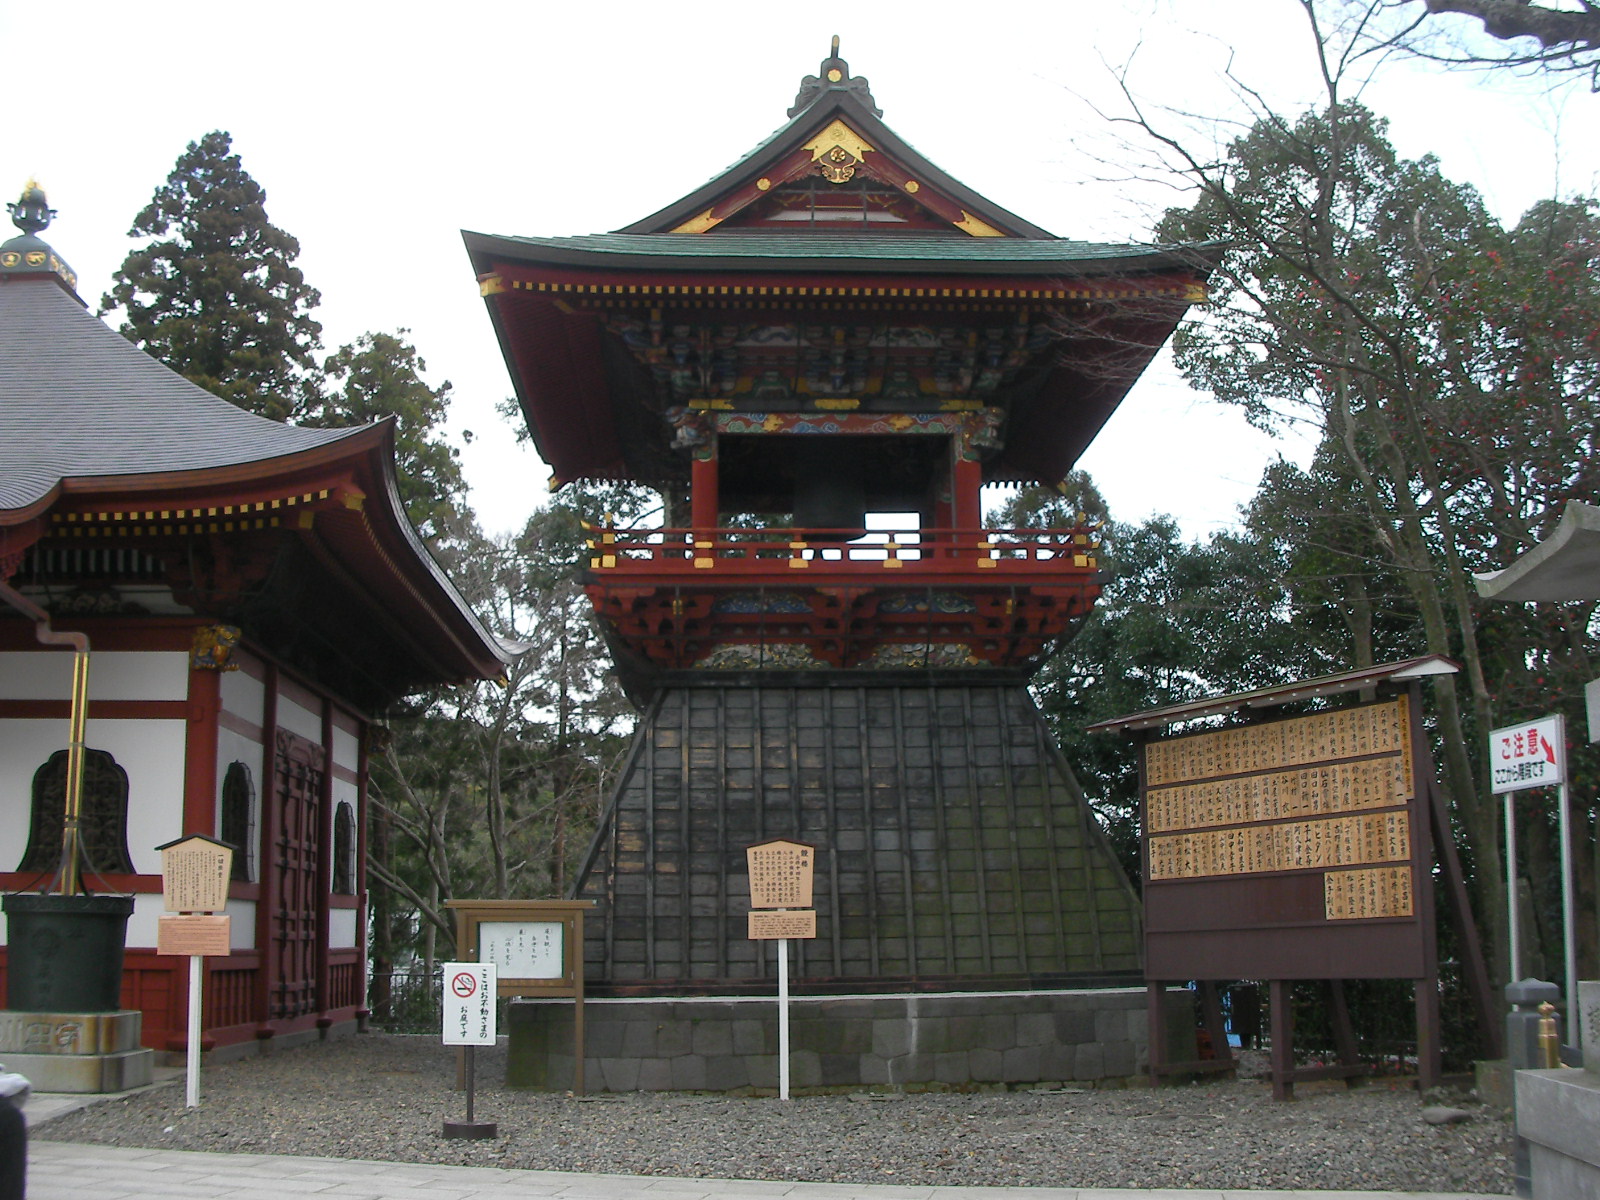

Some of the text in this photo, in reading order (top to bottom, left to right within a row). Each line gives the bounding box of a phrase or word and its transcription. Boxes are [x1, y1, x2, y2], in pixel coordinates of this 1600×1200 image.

[1501, 728, 1538, 760] ご注意
[1495, 760, 1545, 784] ここから階段です
[480, 968, 489, 1039] ここはお不動さまの
